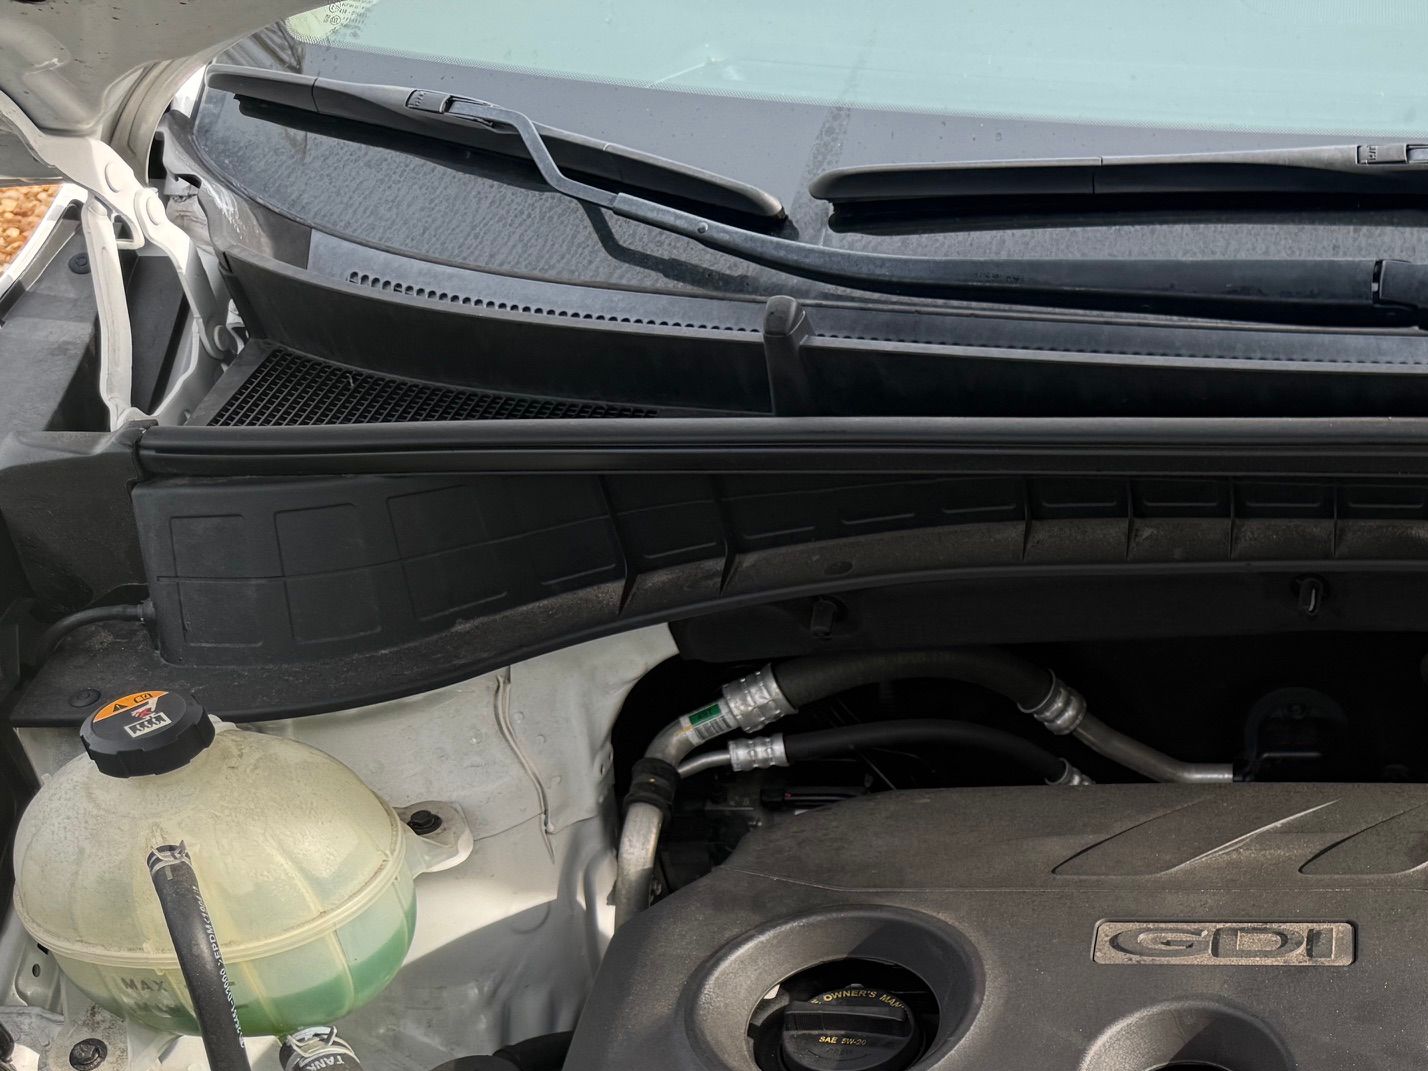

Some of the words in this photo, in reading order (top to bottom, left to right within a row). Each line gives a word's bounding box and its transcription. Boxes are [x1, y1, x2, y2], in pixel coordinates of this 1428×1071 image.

[1109, 927, 1335, 959] GDI
[121, 978, 168, 992] MAX
[822, 990, 877, 1002] OWNER'S
[819, 1036, 838, 1044] SAE
